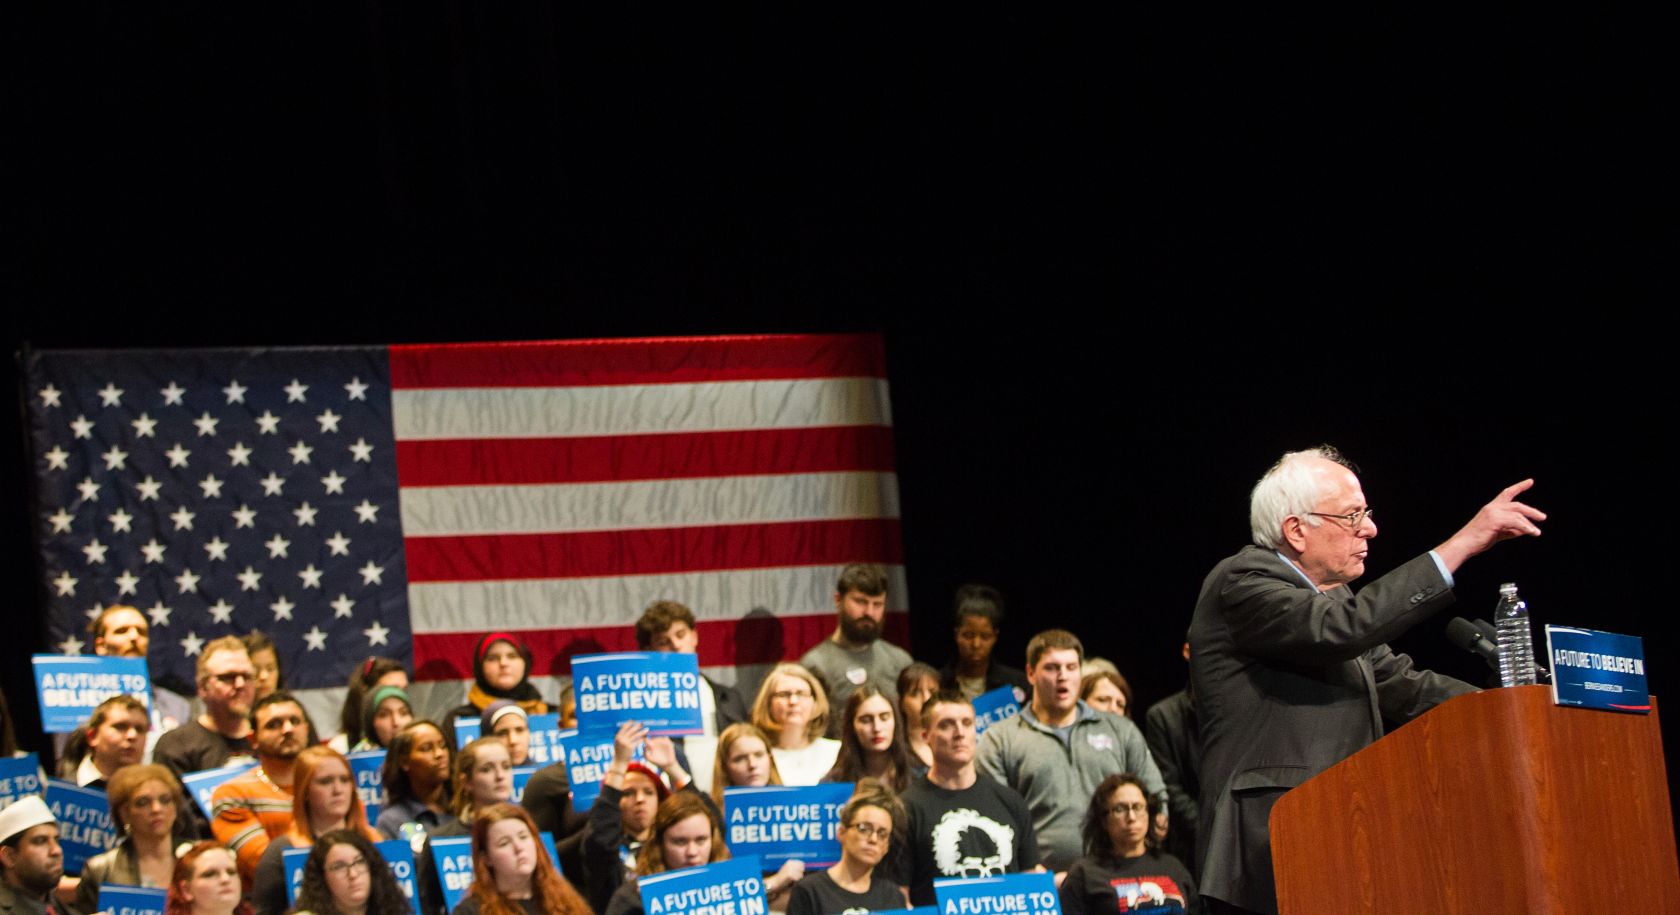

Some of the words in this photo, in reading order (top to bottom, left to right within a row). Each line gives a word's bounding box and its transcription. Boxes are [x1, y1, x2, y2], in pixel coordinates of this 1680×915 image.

[1555, 649, 1561, 664] A
[1561, 650, 1591, 669] FUTURE
[1591, 653, 1601, 670] TO
[1601, 655, 1635, 674] BELIEVE
[1635, 660, 1644, 675] IN
[42, 673, 56, 689] A
[56, 673, 120, 690] FUTURE
[121, 675, 147, 691] TO
[580, 676, 594, 692] A
[597, 672, 668, 690] FUTURE
[671, 672, 697, 689] TO
[580, 690, 671, 712] BELIEVE
[675, 690, 698, 709] IN
[569, 749, 581, 765] A
[15, 774, 38, 791] TO
[64, 803, 115, 830] FUTU
[731, 807, 744, 823] A
[747, 804, 820, 823] FUTURE
[731, 822, 822, 843] BELIEVE
[442, 855, 457, 872] A
[650, 897, 663, 915] A
[664, 883, 732, 911] FUTURE
[733, 877, 760, 896] TO
[945, 898, 958, 915] A
[959, 893, 1027, 914] FUTURE
[1028, 891, 1055, 909] TO
